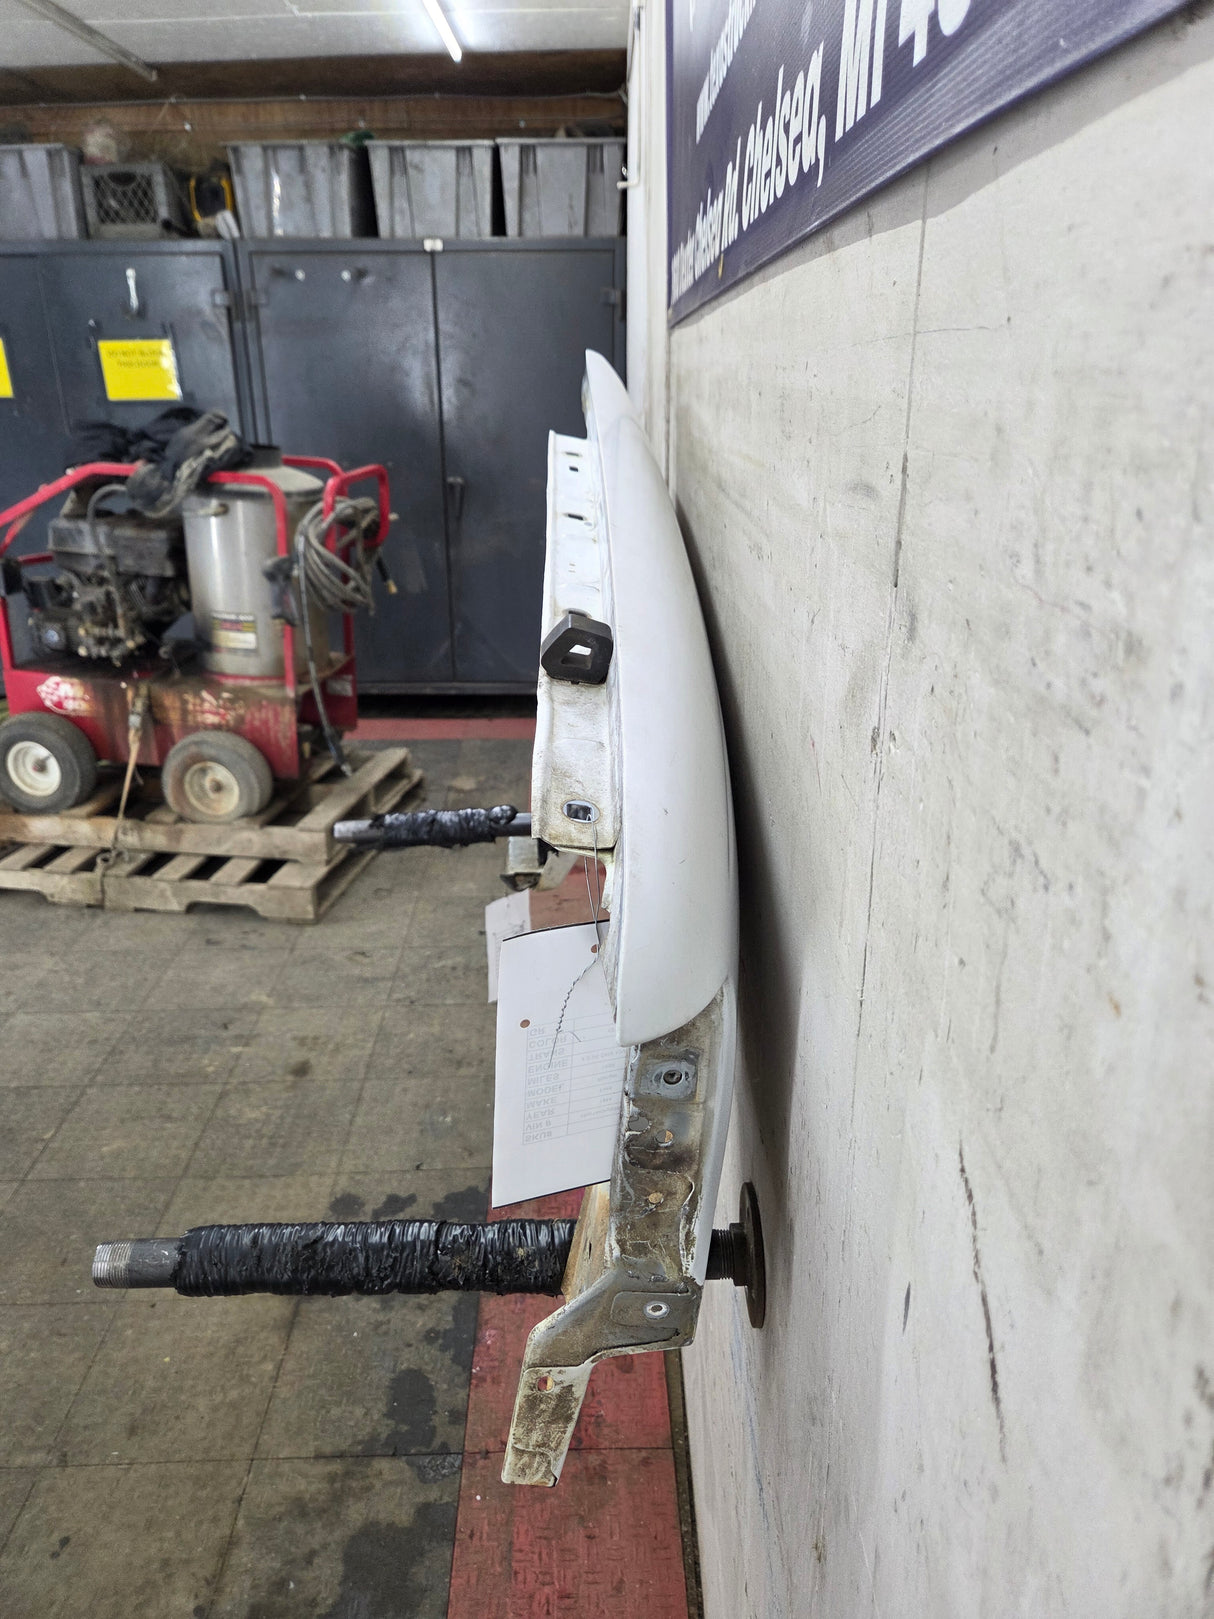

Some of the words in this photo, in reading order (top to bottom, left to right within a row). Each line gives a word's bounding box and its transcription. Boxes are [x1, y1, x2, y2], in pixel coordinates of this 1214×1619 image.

[695, 186, 724, 281] Chelsea
[720, 136, 741, 253] Rd.
[741, 41, 826, 232] Chelsea,
